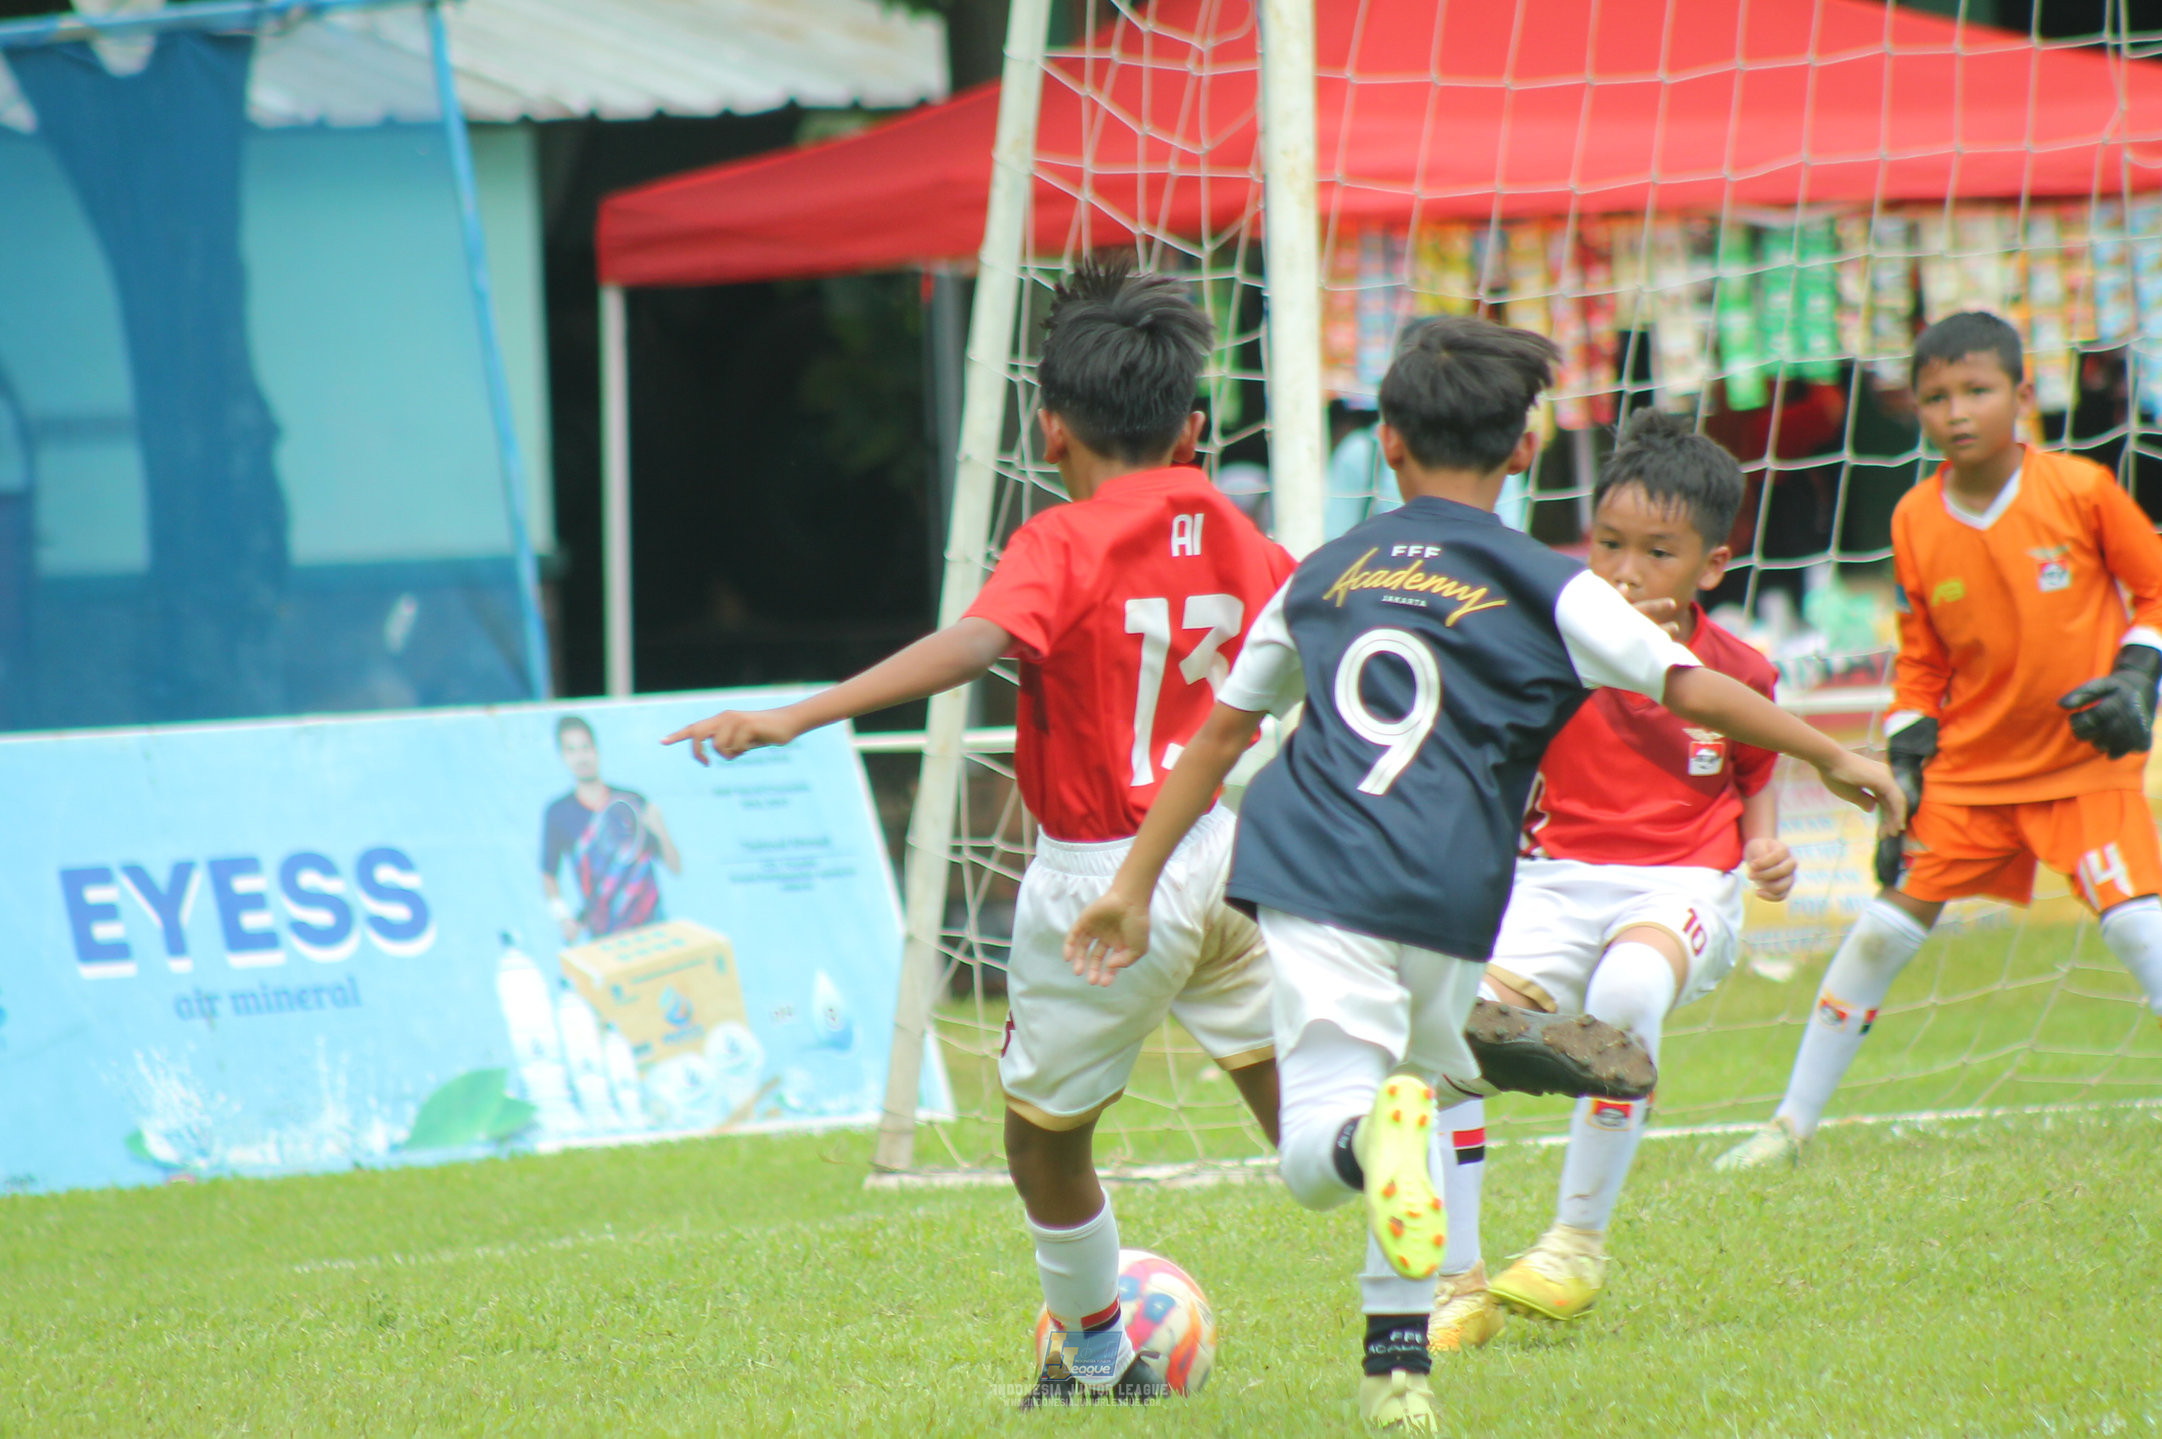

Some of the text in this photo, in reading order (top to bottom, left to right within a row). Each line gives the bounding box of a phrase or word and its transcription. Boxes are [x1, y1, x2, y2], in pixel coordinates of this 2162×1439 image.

[1171, 513, 1205, 557] AI
[1390, 545, 1442, 559] FFF
[1322, 547, 1508, 627] Academy
[1381, 594, 1428, 608] JAKARTA
[1124, 593, 1245, 786] 13
[1334, 627, 1442, 796] 9
[2076, 842, 2134, 912] 14
[60, 847, 434, 976] EYESS
[1682, 907, 1708, 957] 10
[173, 976, 363, 1021] air mineral
